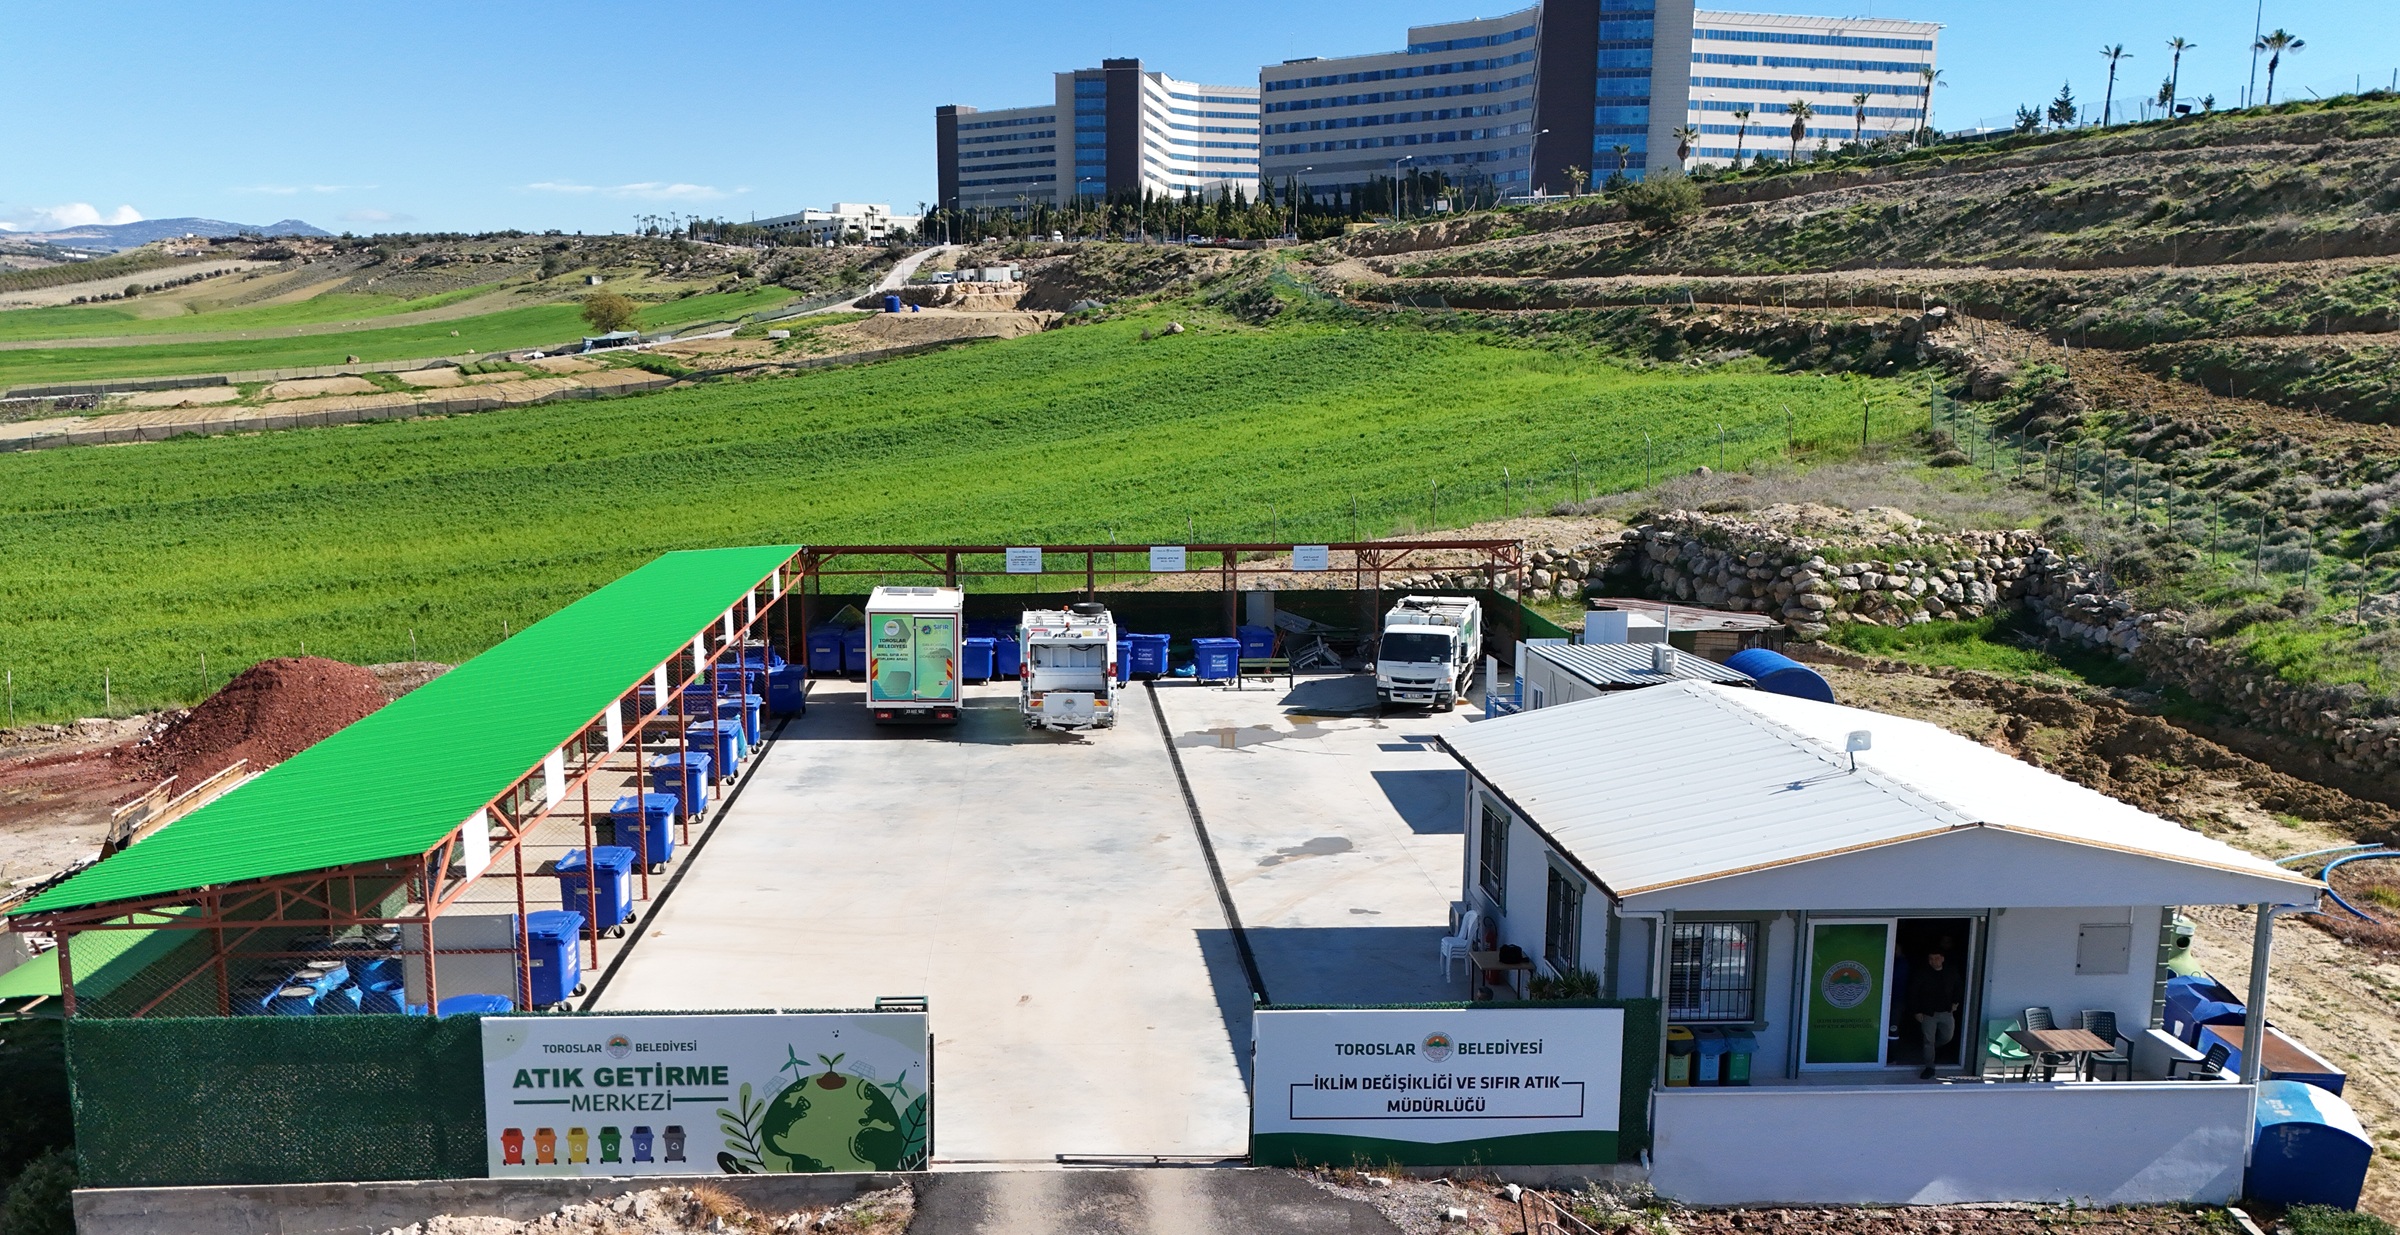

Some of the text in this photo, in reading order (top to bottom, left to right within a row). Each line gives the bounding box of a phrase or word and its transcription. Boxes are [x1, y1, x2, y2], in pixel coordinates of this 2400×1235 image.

[542, 1043, 602, 1054] TOROSLAR
[635, 1039, 697, 1053] BELEDİYESİ
[1334, 1043, 1416, 1056] TOROSLAR
[1458, 1038, 1543, 1055] BELEDİYESİ
[513, 1062, 729, 1089] ATIK GETİRME
[1314, 1073, 1560, 1093] İKLİM DEĞİŞİKLİĞİ VE SIFIR ATIK
[572, 1090, 672, 1113] MERKEZİ
[1387, 1097, 1486, 1113] MÜDÜRLÜĞÜ
